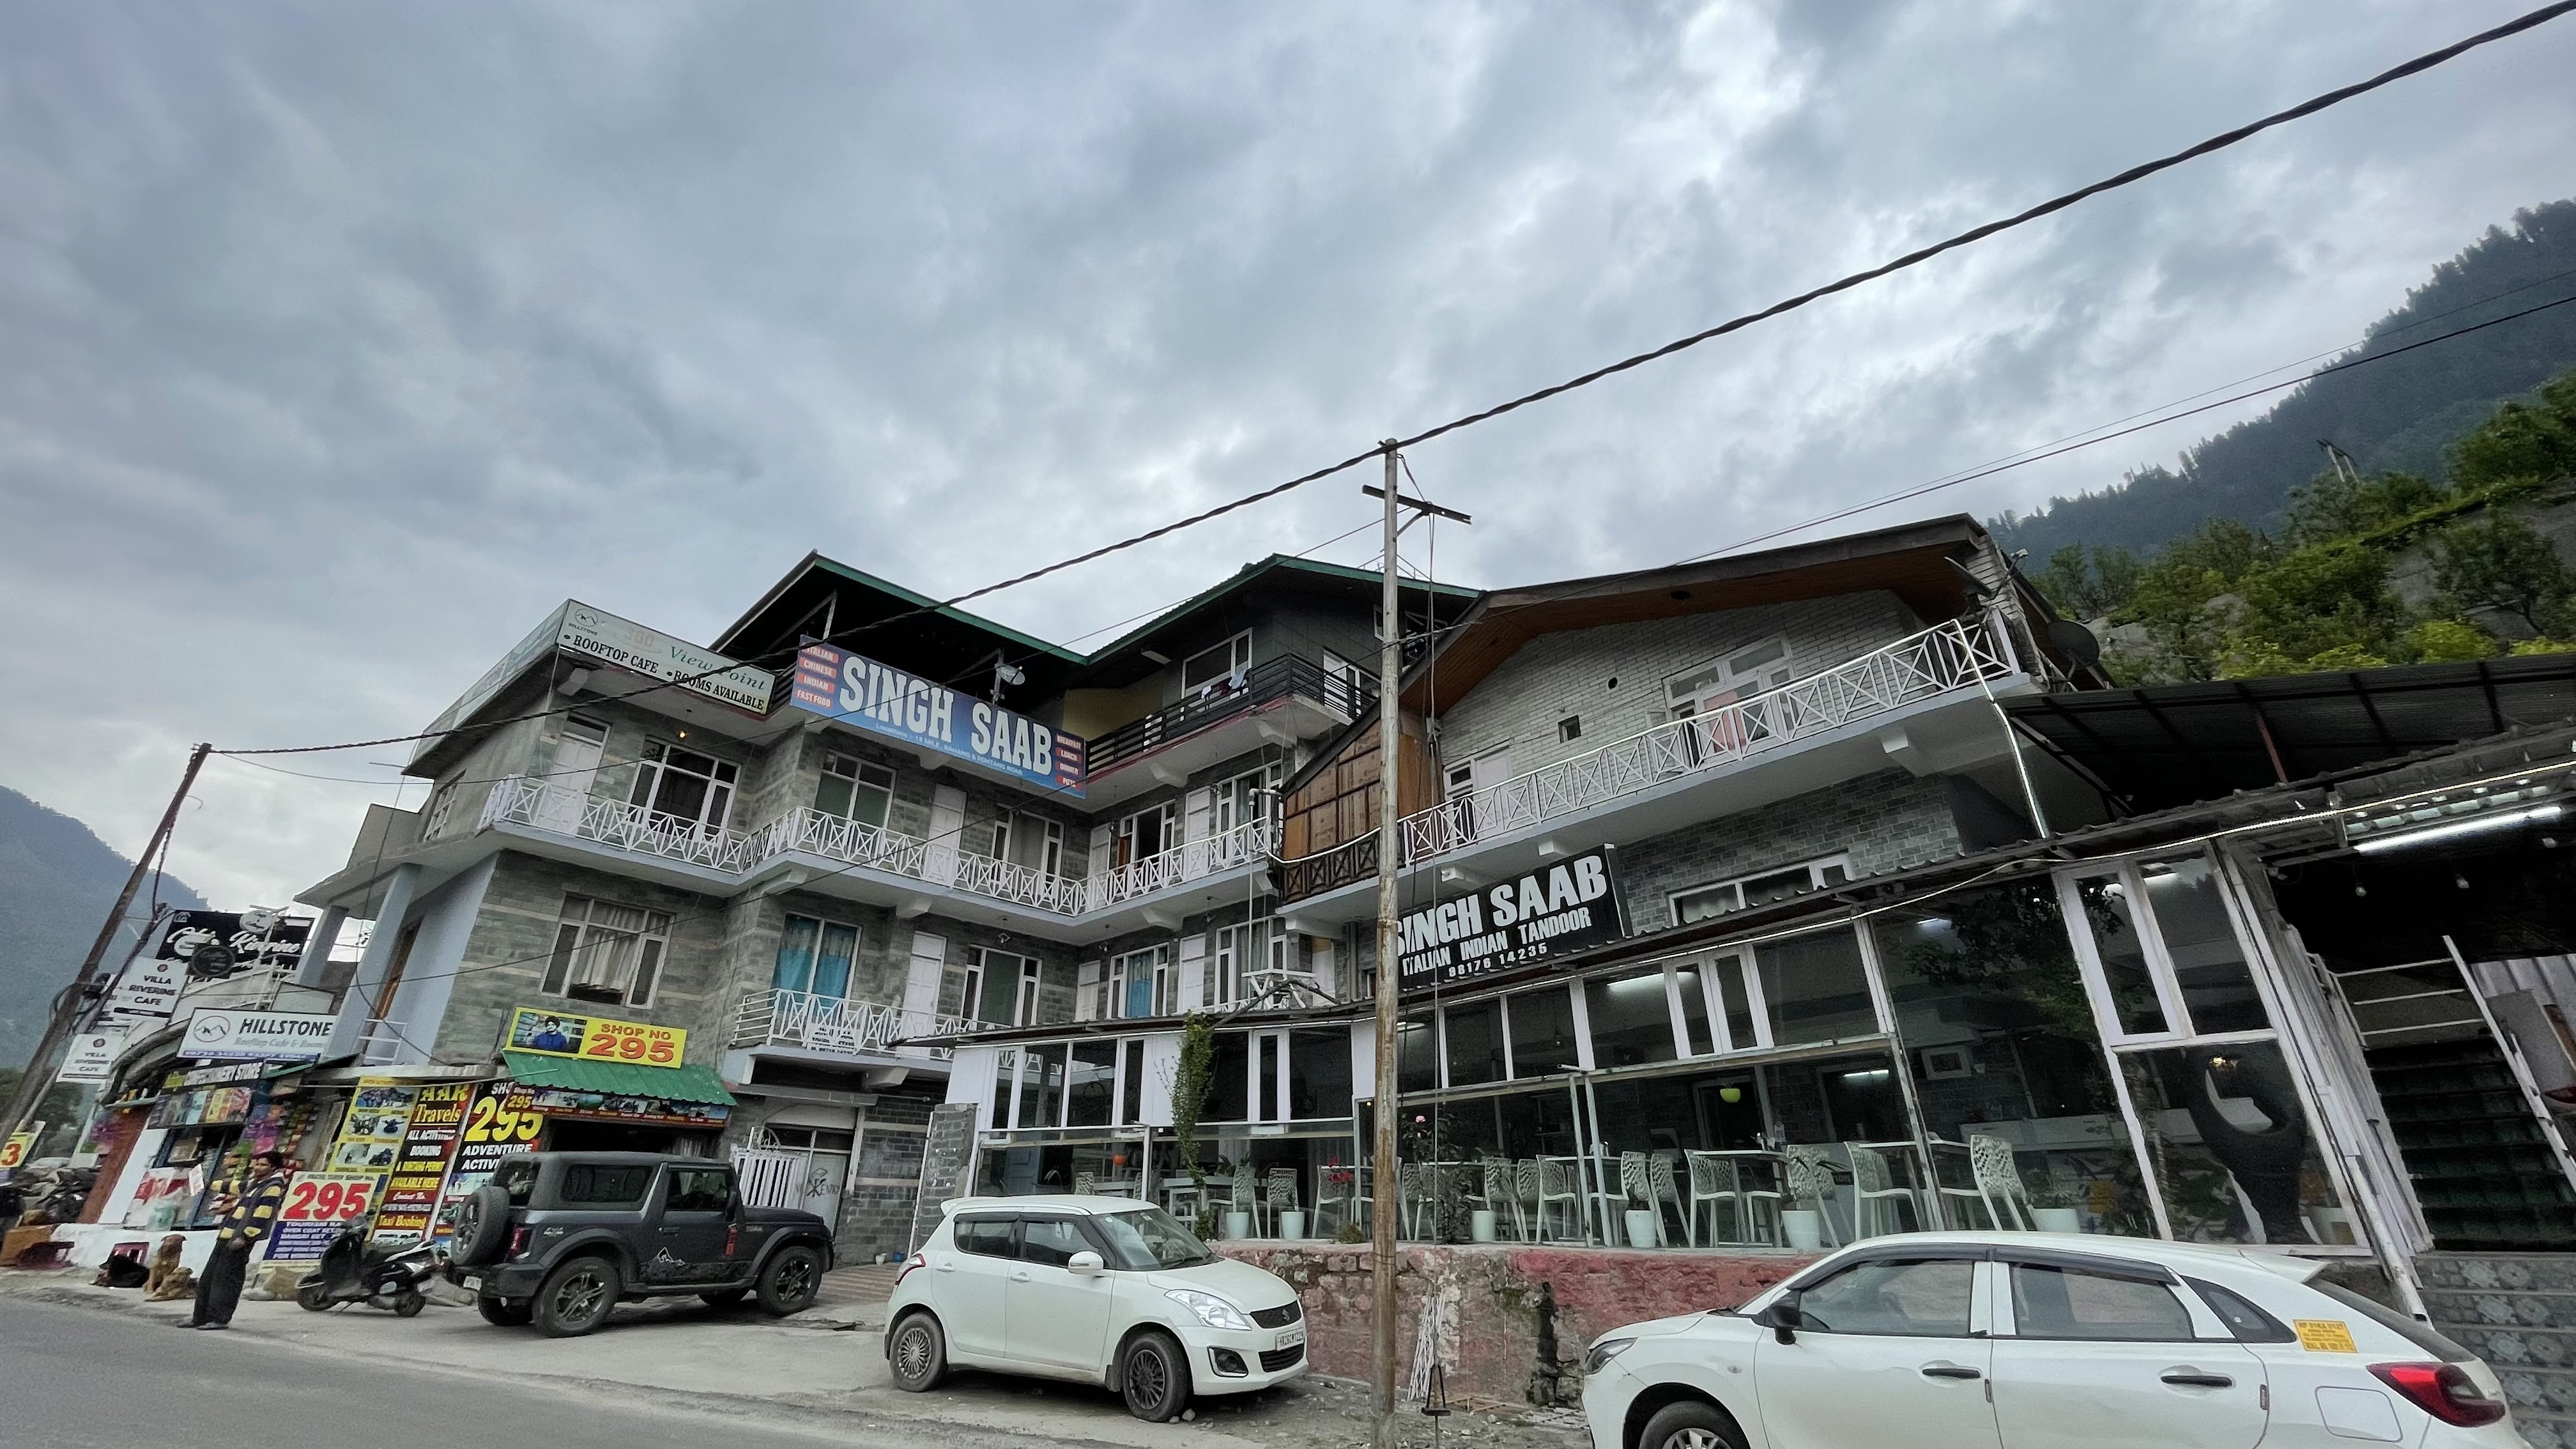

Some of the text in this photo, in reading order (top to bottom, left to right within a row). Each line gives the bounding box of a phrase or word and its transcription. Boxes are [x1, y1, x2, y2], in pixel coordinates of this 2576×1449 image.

[569, 622, 598, 636] HILLSTONE
[573, 634, 659, 674] ROOFTOP CAFE
[806, 645, 834, 662] ITALIAN
[671, 646, 766, 690] View Point
[804, 659, 832, 676] CHINESE
[674, 670, 765, 710] ROOMS AVAILABLE
[804, 676, 829, 691] INDIAN
[797, 689, 831, 707] FAST FOOD
[839, 656, 1052, 776] SINGH SAAB
[1491, 855, 1607, 926] SAAB
[1402, 907, 1591, 976] ITALIAN INDIAN TANDOOR
[1499, 942, 1547, 965] 14235
[144, 975, 171, 985] VILLA
[134, 997, 162, 1006] CAFE
[239, 1018, 333, 1036] HILLSTONE
[601, 1023, 671, 1040] SHOP NO
[587, 1034, 675, 1062] 295
[507, 1095, 533, 1108] 295
[414, 1103, 462, 1123] Travels
[464, 1096, 544, 1142] 295
[406, 1130, 420, 1140] ALL
[410, 1146, 442, 1156] BOOKING
[462, 1144, 533, 1156] ADVENTURE
[283, 1182, 371, 1220] 295
[378, 1215, 427, 1229] Taxi Booking
